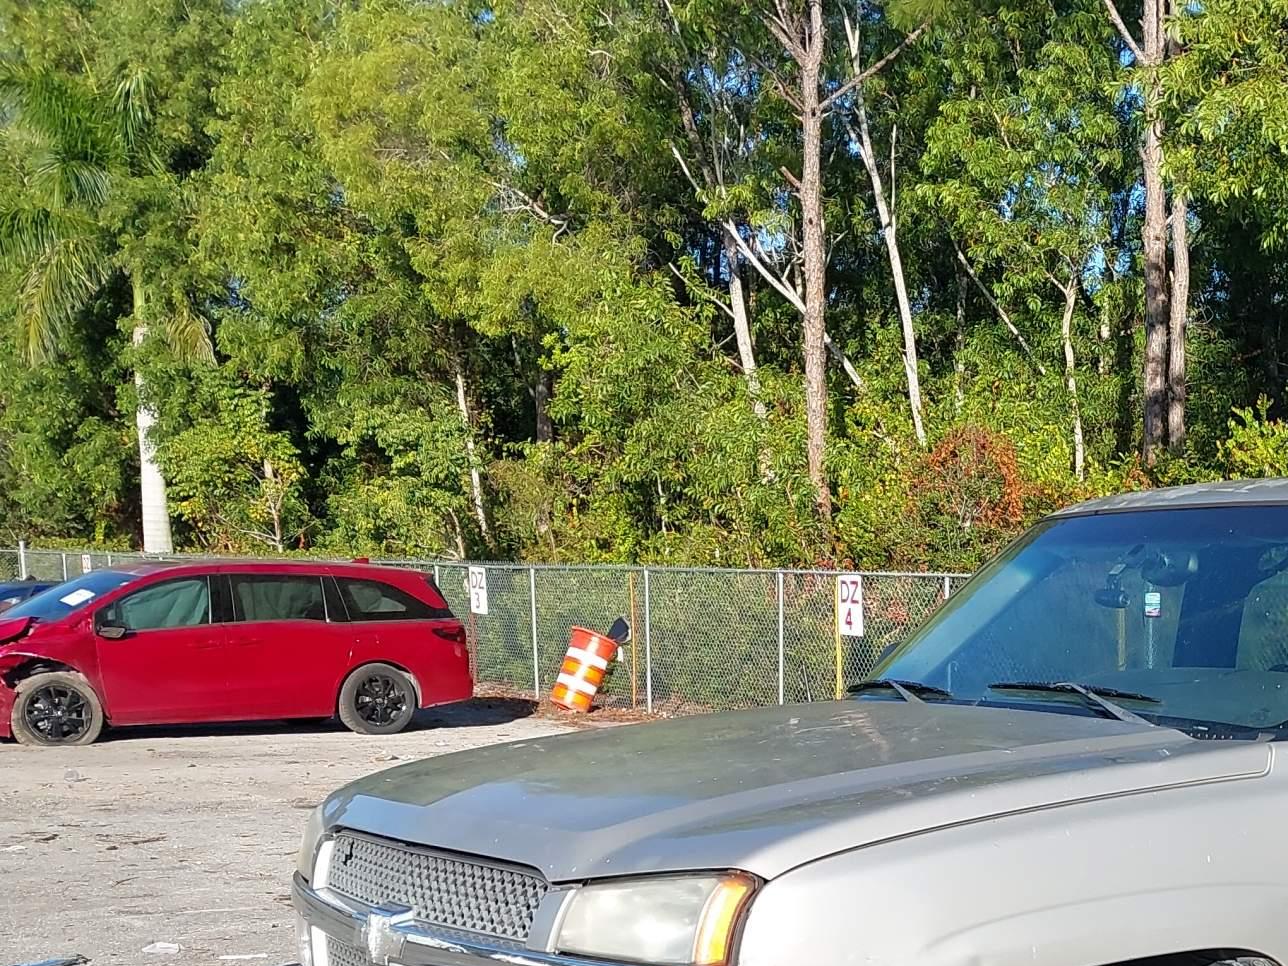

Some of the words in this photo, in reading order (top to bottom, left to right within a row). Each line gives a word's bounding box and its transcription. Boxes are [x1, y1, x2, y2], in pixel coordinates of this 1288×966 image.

[471, 571, 485, 590] DZ
[474, 592, 481, 609] 3
[840, 580, 860, 604] DZ
[845, 608, 853, 631] 4
